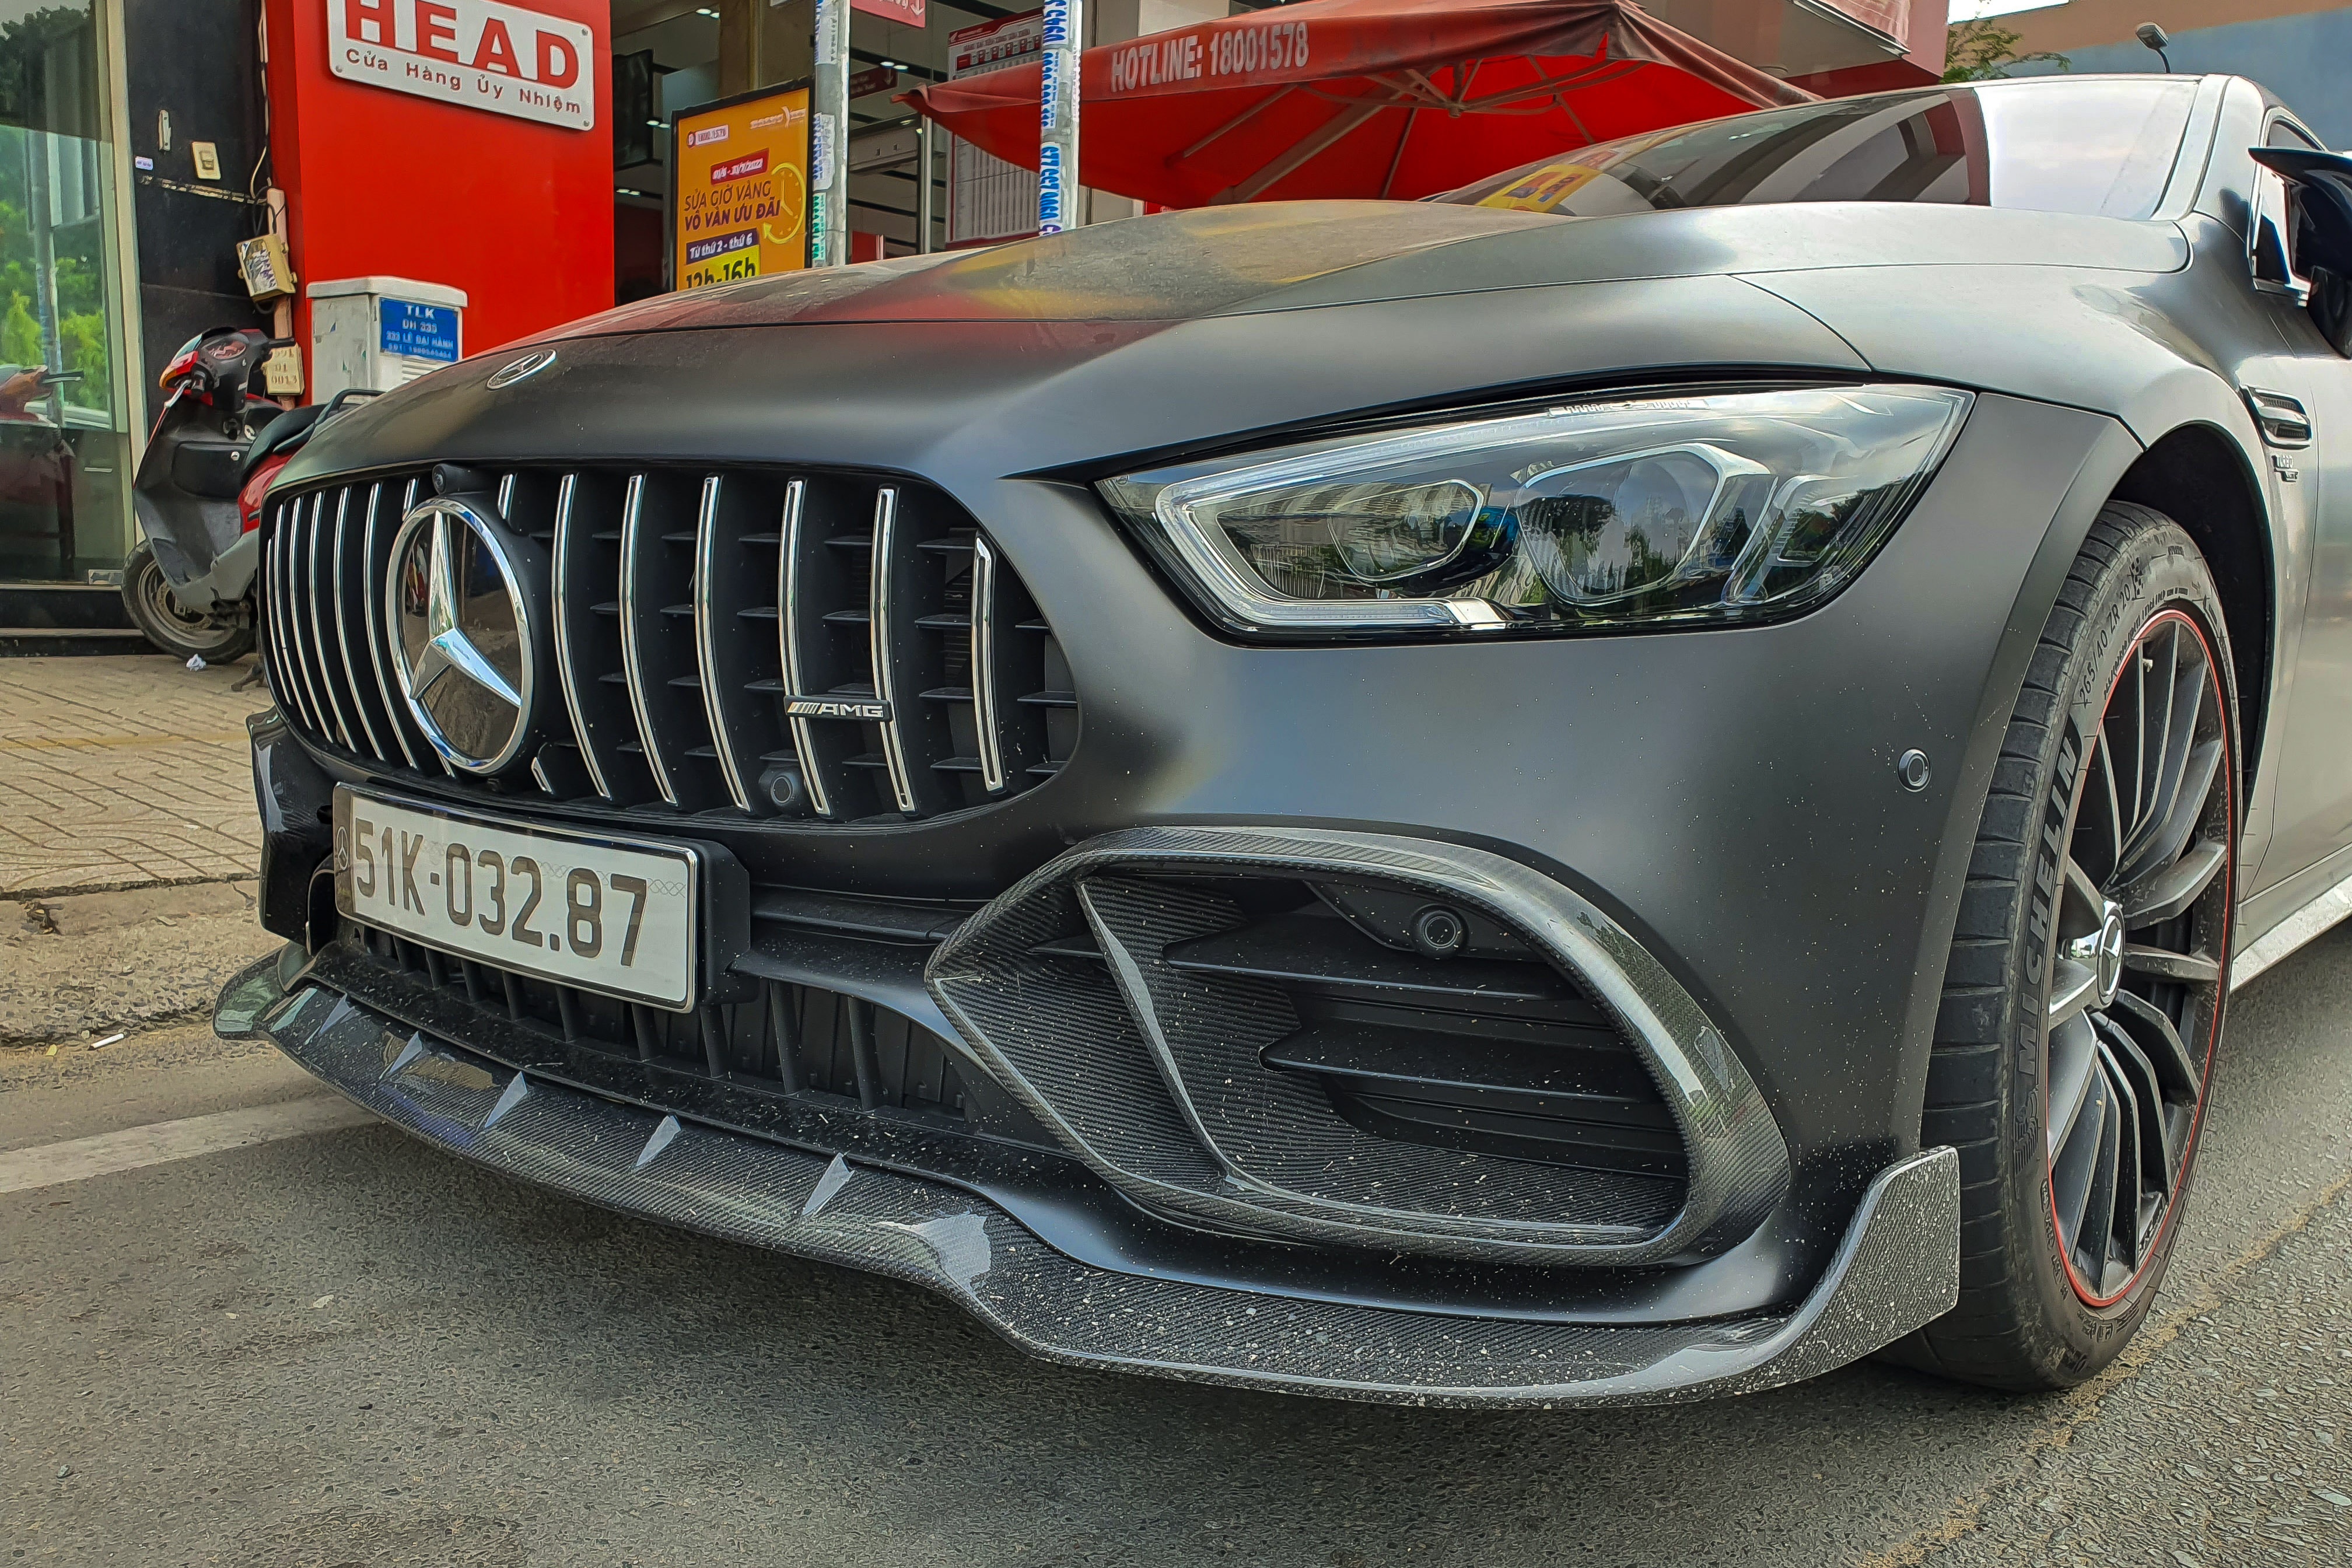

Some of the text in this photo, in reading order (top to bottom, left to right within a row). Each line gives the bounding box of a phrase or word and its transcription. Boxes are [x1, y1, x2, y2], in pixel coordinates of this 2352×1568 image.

[345, 0, 579, 89] HEAD
[1111, 34, 1203, 93] HOTLINE:
[1209, 22, 1309, 76] 18001578
[346, 48, 580, 114] Cửa Hàng Ủy Nhiệm
[684, 180, 772, 212] SỬA GIỜ VÀNG
[684, 196, 781, 232] VÔ VÀN ƯU ĐÃI
[690, 244, 701, 260] Từ
[701, 241, 716, 254] thứ
[716, 240, 723, 253] 2
[729, 233, 746, 249] thứ
[746, 232, 752, 246] 6
[404, 303, 435, 320] TLK
[2078, 629, 2109, 706] 265/40
[2106, 603, 2120, 635] ZR
[2119, 583, 2130, 611] 20
[816, 702, 884, 718] AMG
[355, 817, 649, 968] 51K-032.87
[2018, 736, 2078, 1076] MICHELIN
